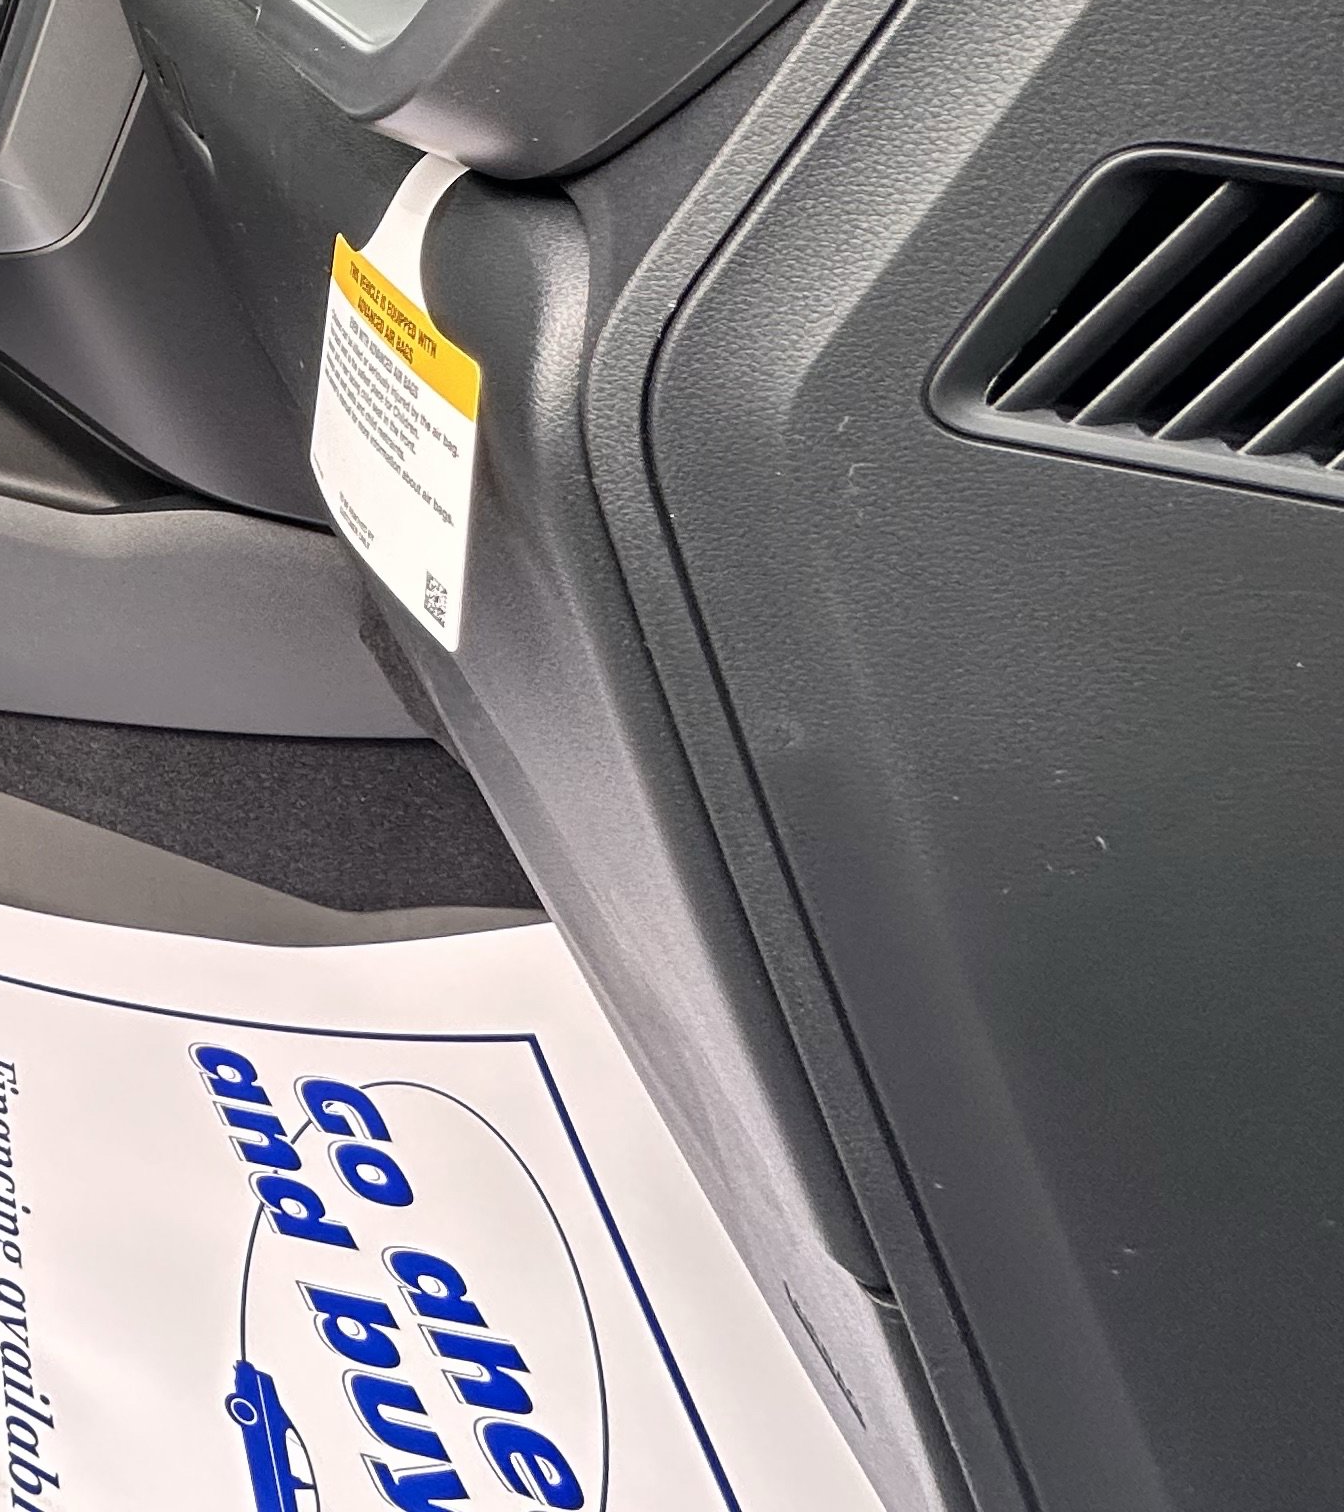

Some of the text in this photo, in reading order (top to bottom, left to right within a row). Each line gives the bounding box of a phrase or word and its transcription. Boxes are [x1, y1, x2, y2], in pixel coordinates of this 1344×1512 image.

[384, 324, 394, 347] AIR
[395, 335, 413, 364] BAGS
[386, 299, 416, 341] EQUIPPED
[418, 328, 436, 359] WITH
[411, 403, 418, 422] by
[420, 413, 430, 431] the
[432, 426, 441, 441] air
[442, 433, 459, 458] bag.
[402, 469, 420, 494] about
[422, 490, 432, 504] air
[433, 497, 453, 526] bags.
[188, 1042, 359, 1250] and
[294, 1076, 585, 1512] Go ahe
